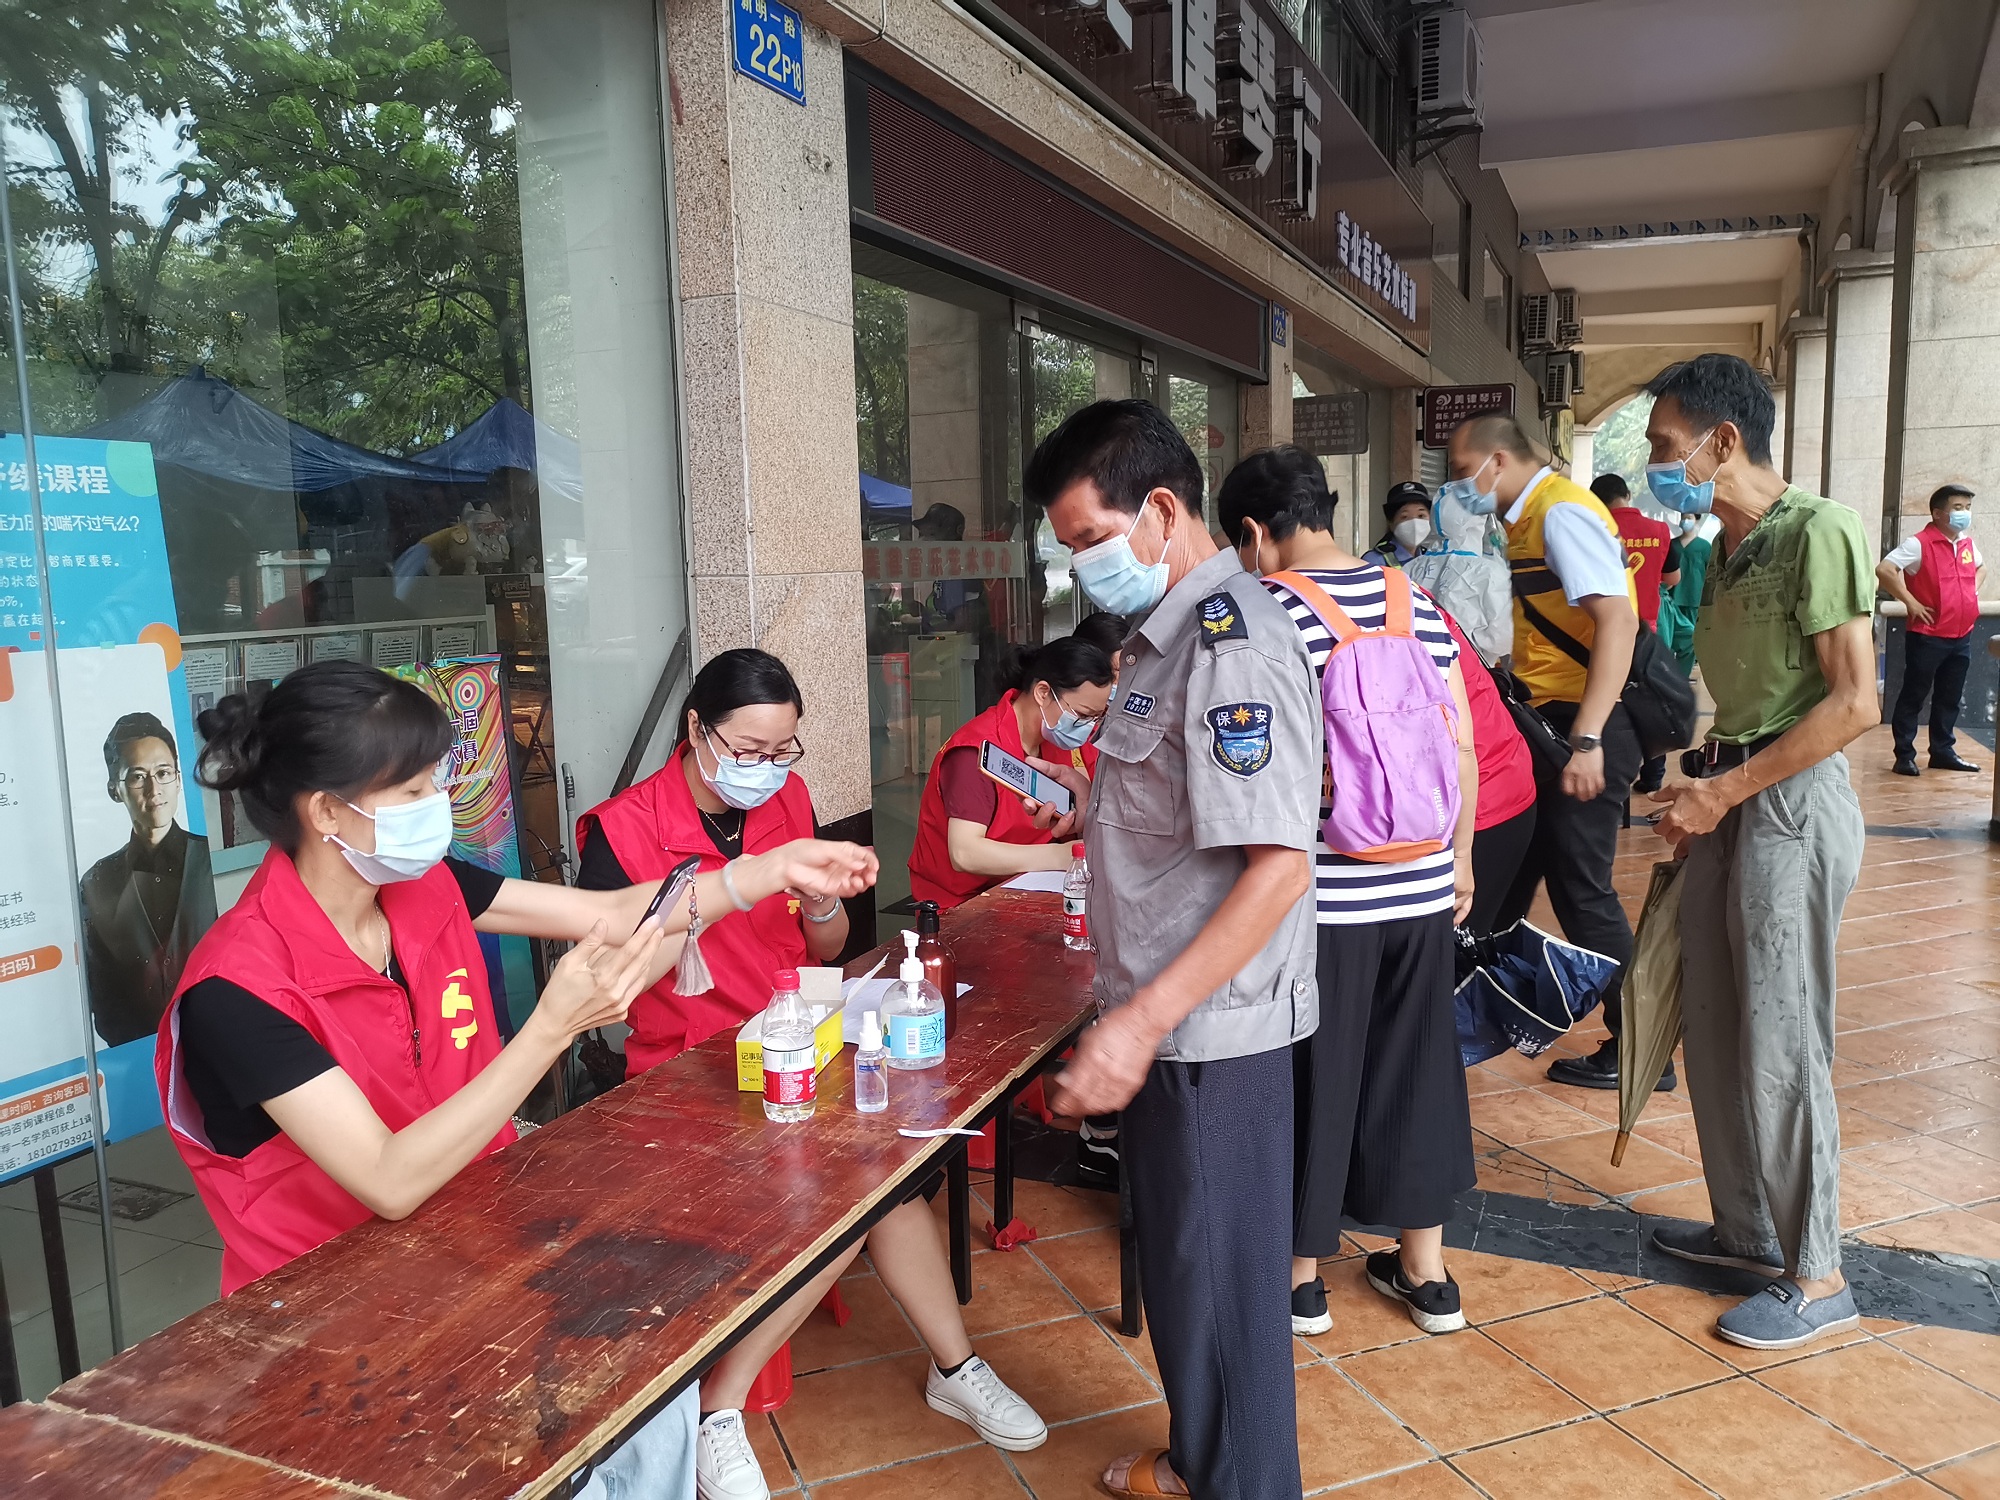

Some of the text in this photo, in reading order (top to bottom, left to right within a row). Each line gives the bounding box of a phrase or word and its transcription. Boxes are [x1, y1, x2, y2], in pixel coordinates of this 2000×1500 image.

[750, 24, 802, 92] 22P18
[1337, 210, 1417, 323] 专业音乐艺术培训
[0, 461, 111, 494] 缓课程
[0, 554, 120, 569] 定比智商更重要。
[1216, 708, 1268, 727] 保安
[436, 739, 479, 768] 大賽
